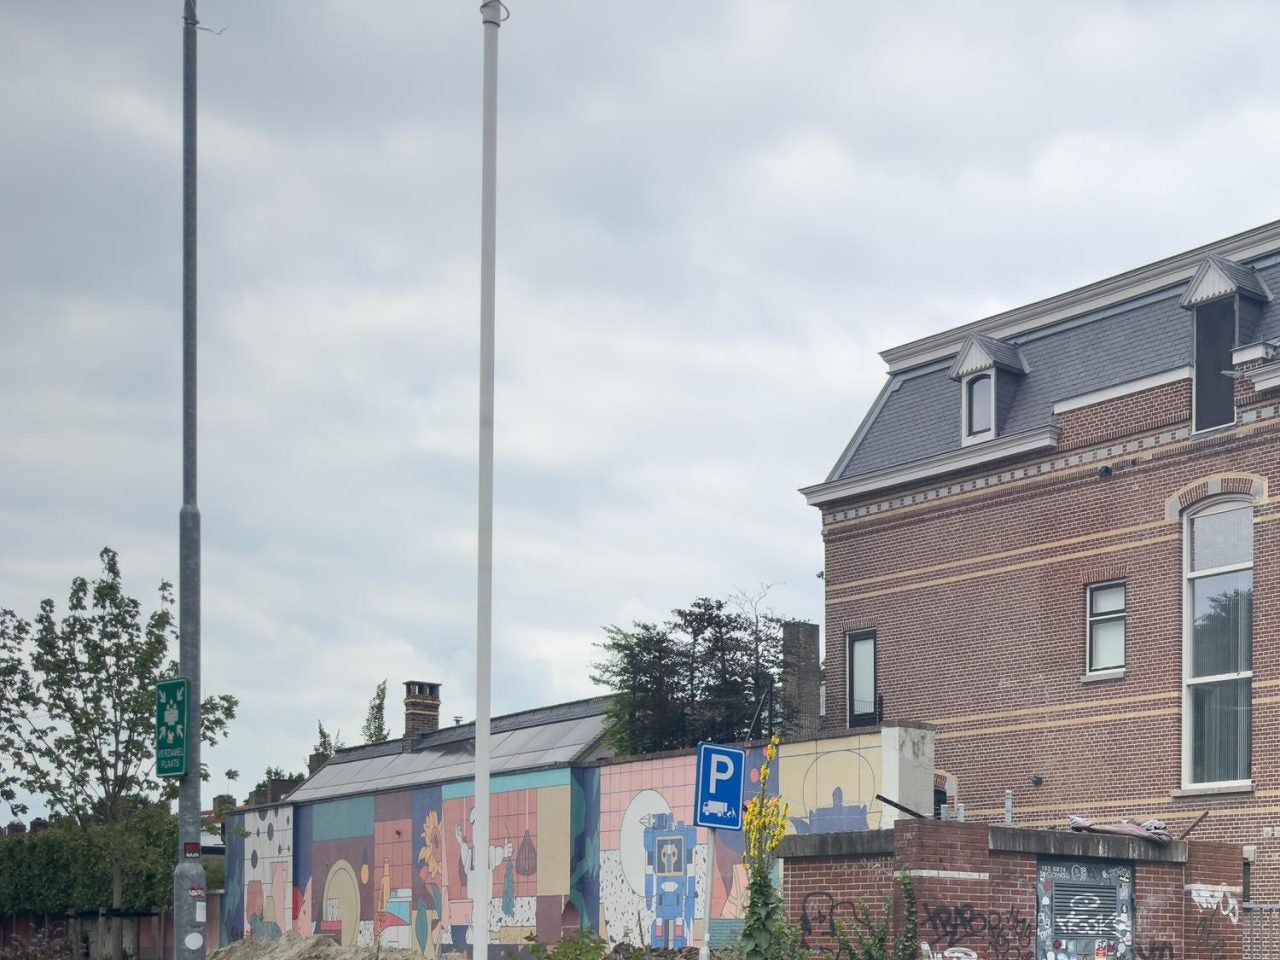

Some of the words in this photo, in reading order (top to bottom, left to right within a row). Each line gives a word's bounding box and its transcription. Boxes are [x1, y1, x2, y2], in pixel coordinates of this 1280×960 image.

[158, 747, 184, 758] VERZAMEL
[160, 759, 180, 768] PLAATS
[709, 753, 735, 794] P
